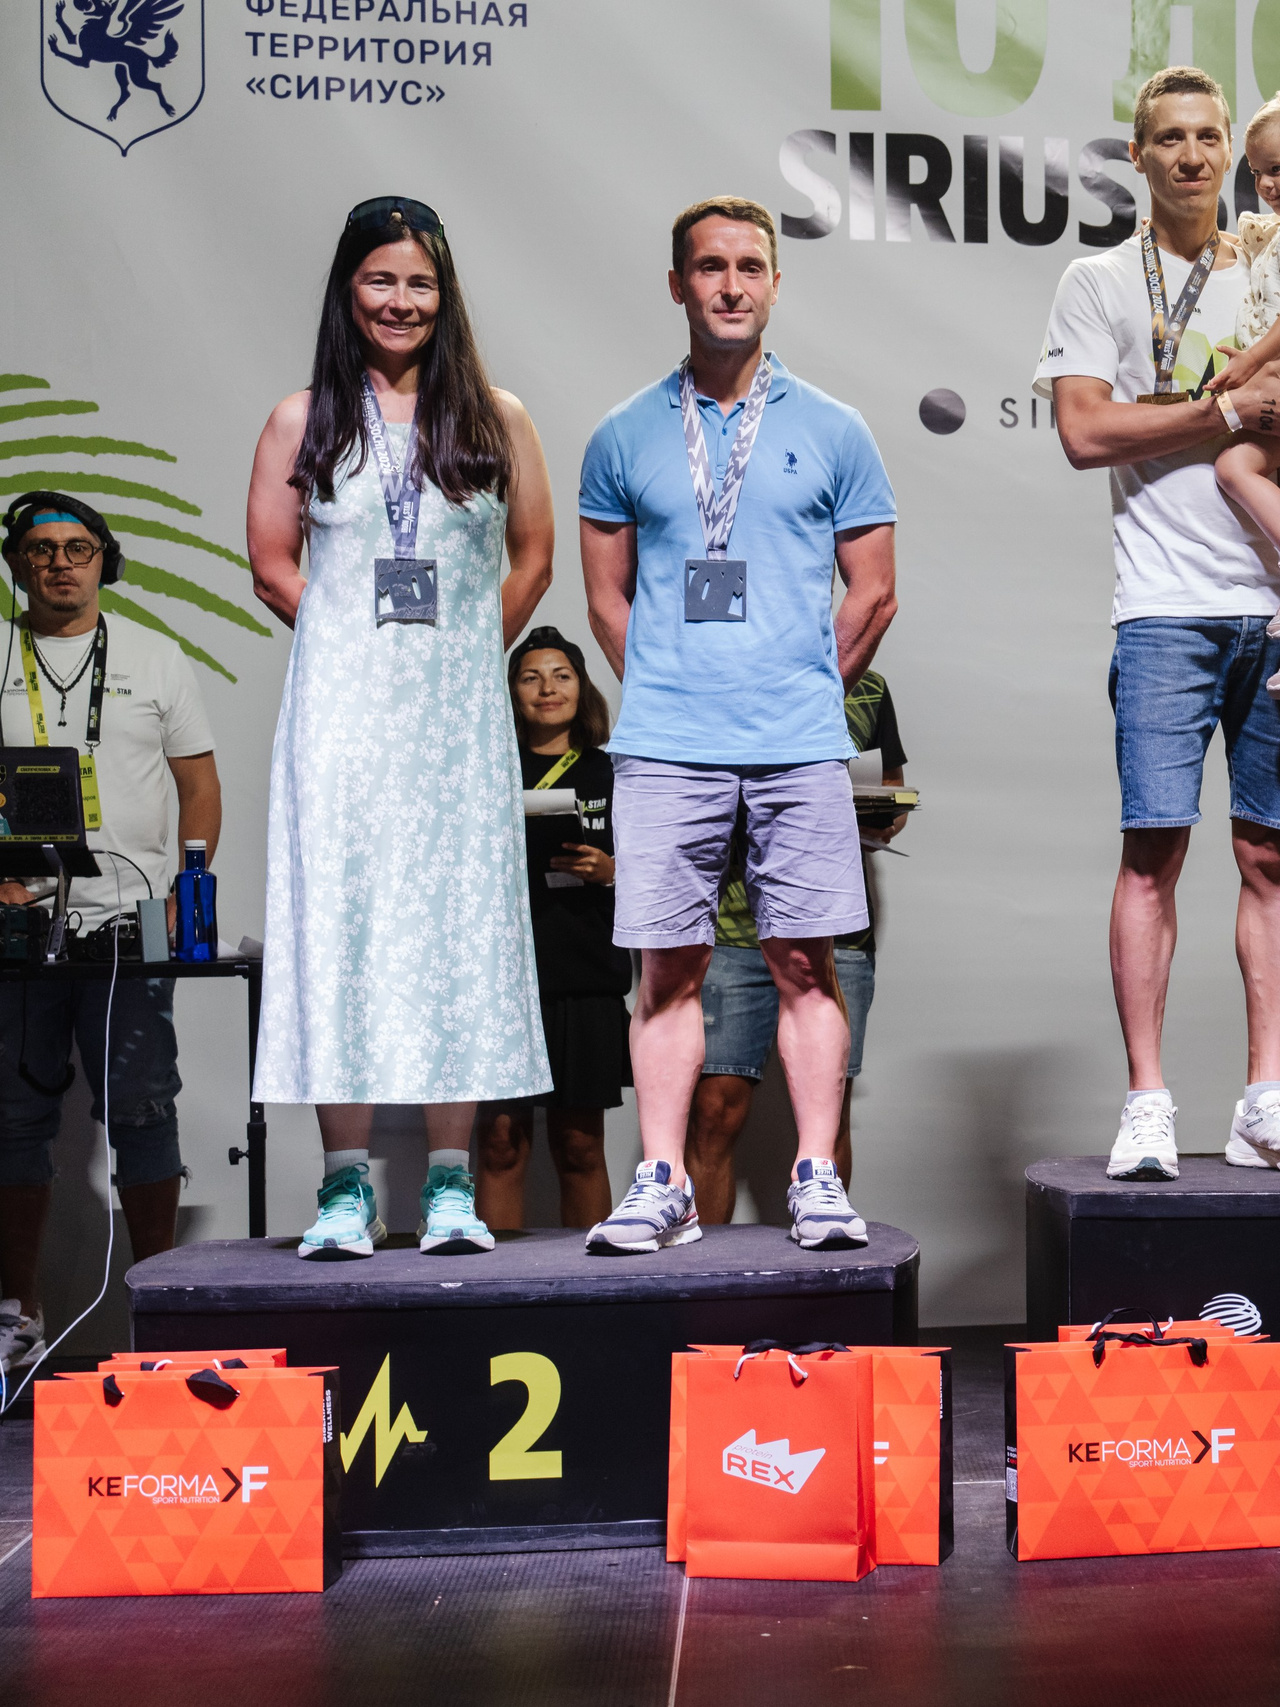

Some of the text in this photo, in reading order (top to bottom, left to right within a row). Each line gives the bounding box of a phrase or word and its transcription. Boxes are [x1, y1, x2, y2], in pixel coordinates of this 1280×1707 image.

[245, 0, 528, 28] ФЕДЕРАЛЬНАЯ
[245, 31, 492, 66] ТЕРРИТОРИЯ
[245, 73, 446, 105] «СИРИУС»
[779, 129, 1133, 248] SIRIUS
[1149, 272, 1161, 294] SOCHI
[1153, 294, 1165, 314] 2024
[370, 423, 386, 450] SOCHI
[116, 688, 132, 696] STAR
[80, 766, 93, 776] TAR
[588, 797, 607, 809] STAR
[582, 817, 605, 831] AM
[325, 1389, 333, 1443] WELLNESS
[488, 1351, 563, 1481] 2
[731, 1443, 774, 1460] protein
[1068, 1437, 1192, 1464] KEFORMA
[727, 1452, 795, 1491] REX
[1129, 1458, 1192, 1468] SPORT NUTRITION
[88, 1474, 220, 1498] KEFORMA
[152, 1496, 220, 1505] SPORT NUTRITION
